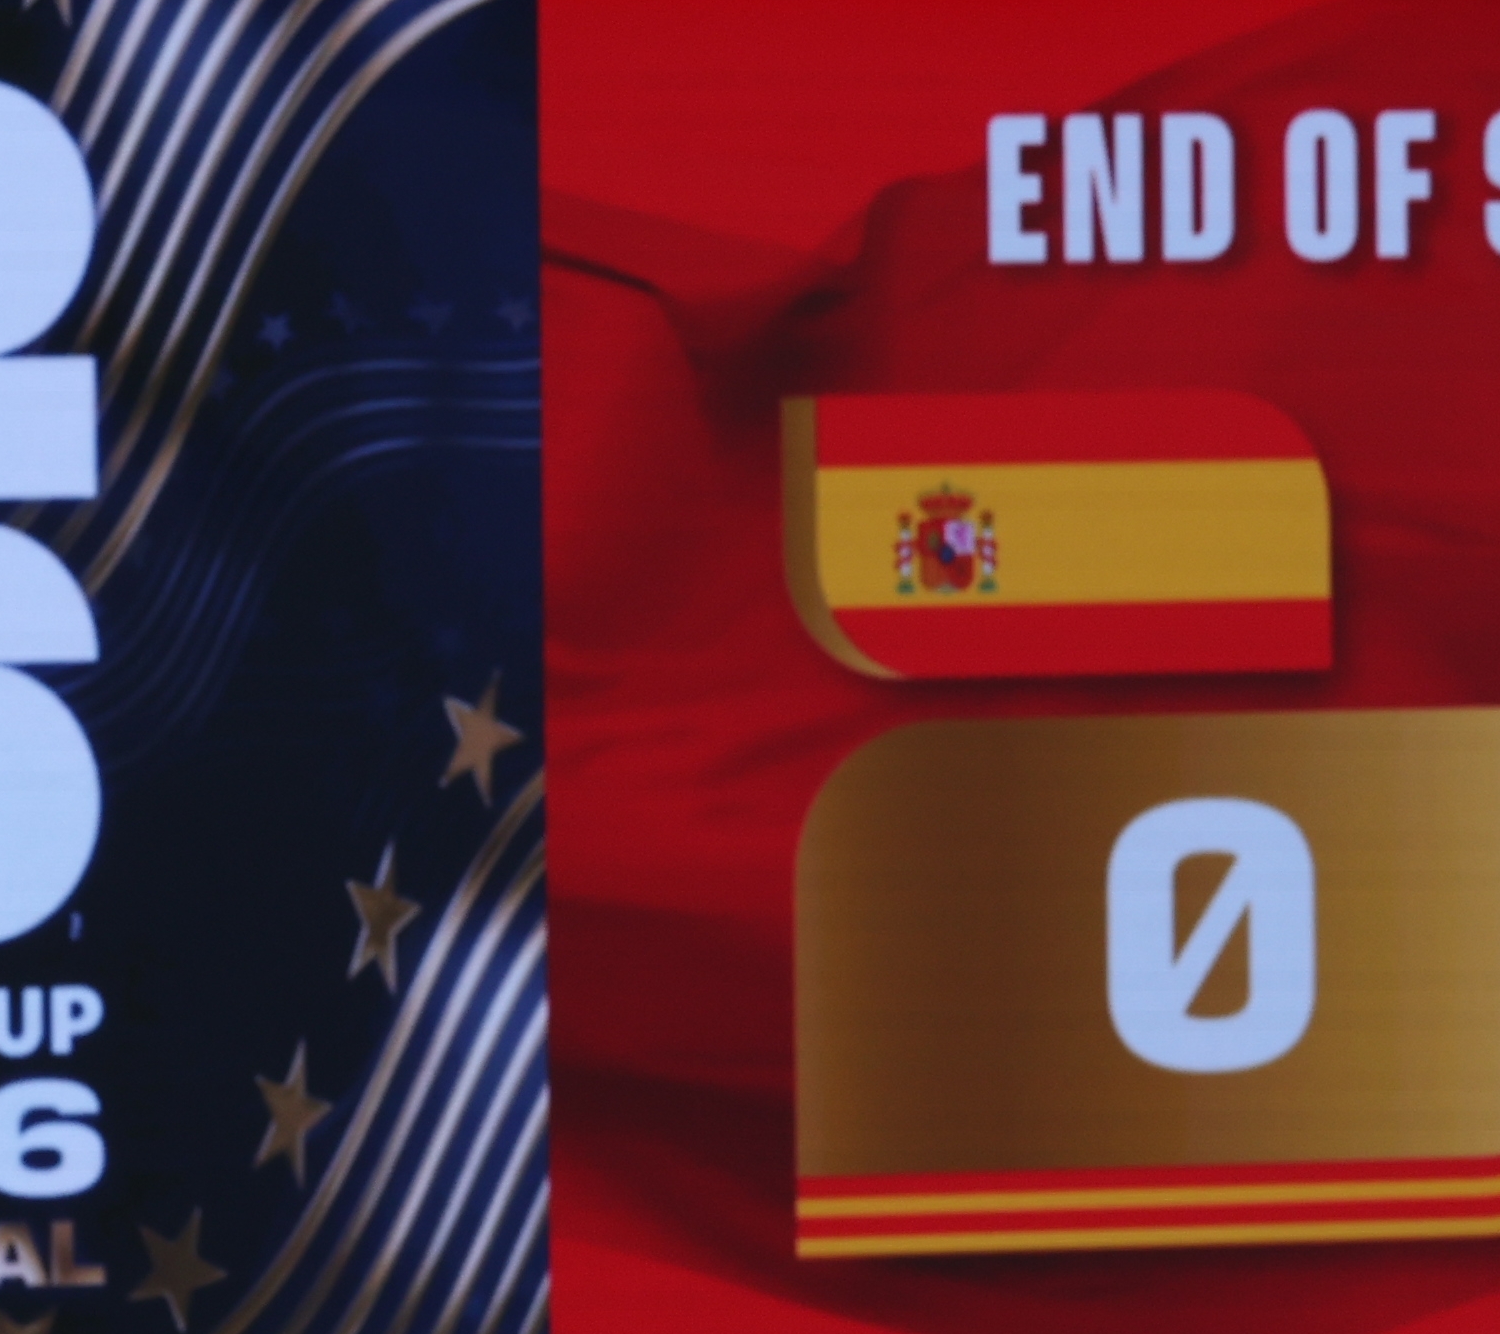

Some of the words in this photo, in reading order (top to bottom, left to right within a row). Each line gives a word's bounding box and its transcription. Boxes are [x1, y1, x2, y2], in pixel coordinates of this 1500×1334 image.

[988, 114, 1234, 263] END
[1285, 110, 1435, 261] OF
[1106, 797, 1317, 1073] 0
